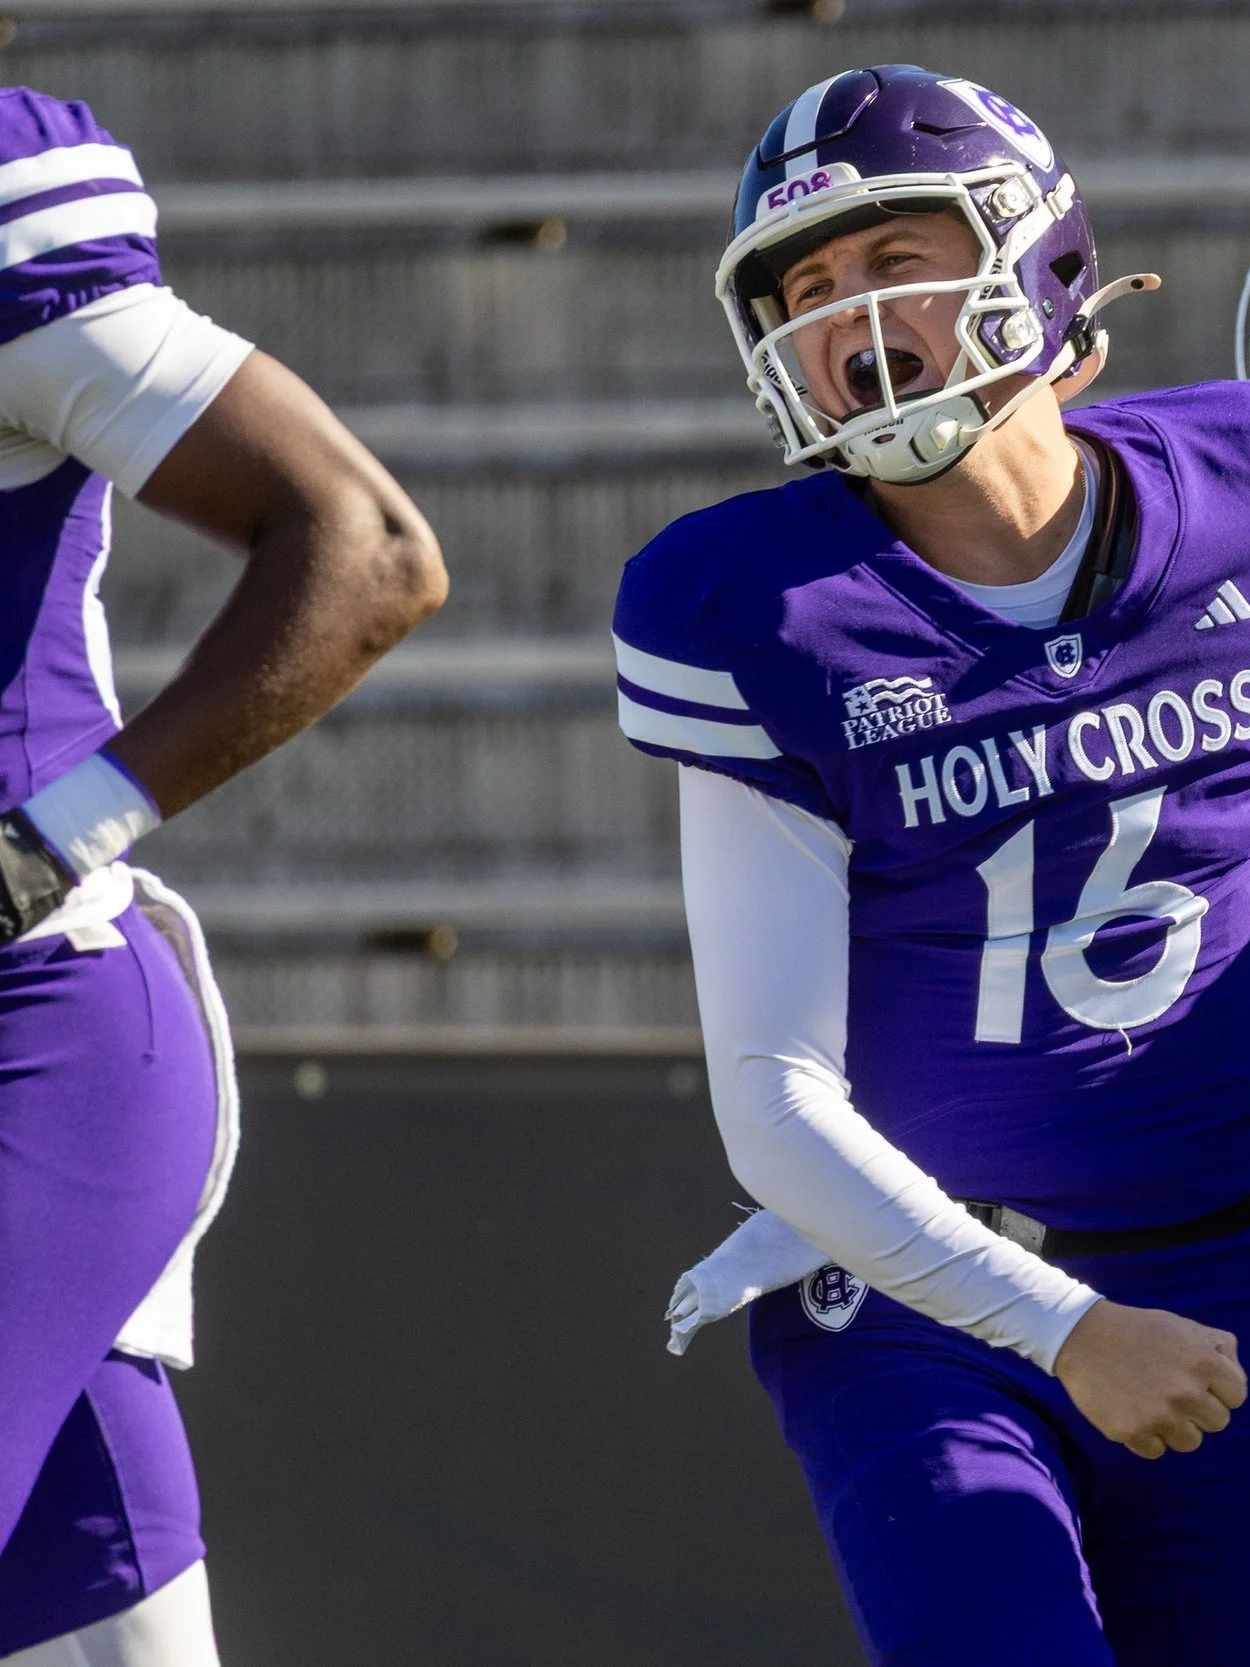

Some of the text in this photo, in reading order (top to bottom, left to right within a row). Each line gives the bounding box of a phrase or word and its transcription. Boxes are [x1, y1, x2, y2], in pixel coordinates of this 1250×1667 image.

[767, 170, 833, 210] 508
[841, 693, 946, 737] PATRIOT
[845, 707, 952, 750] LEAGUE
[895, 725, 1053, 828] HOLY
[974, 785, 1209, 1044] 16
